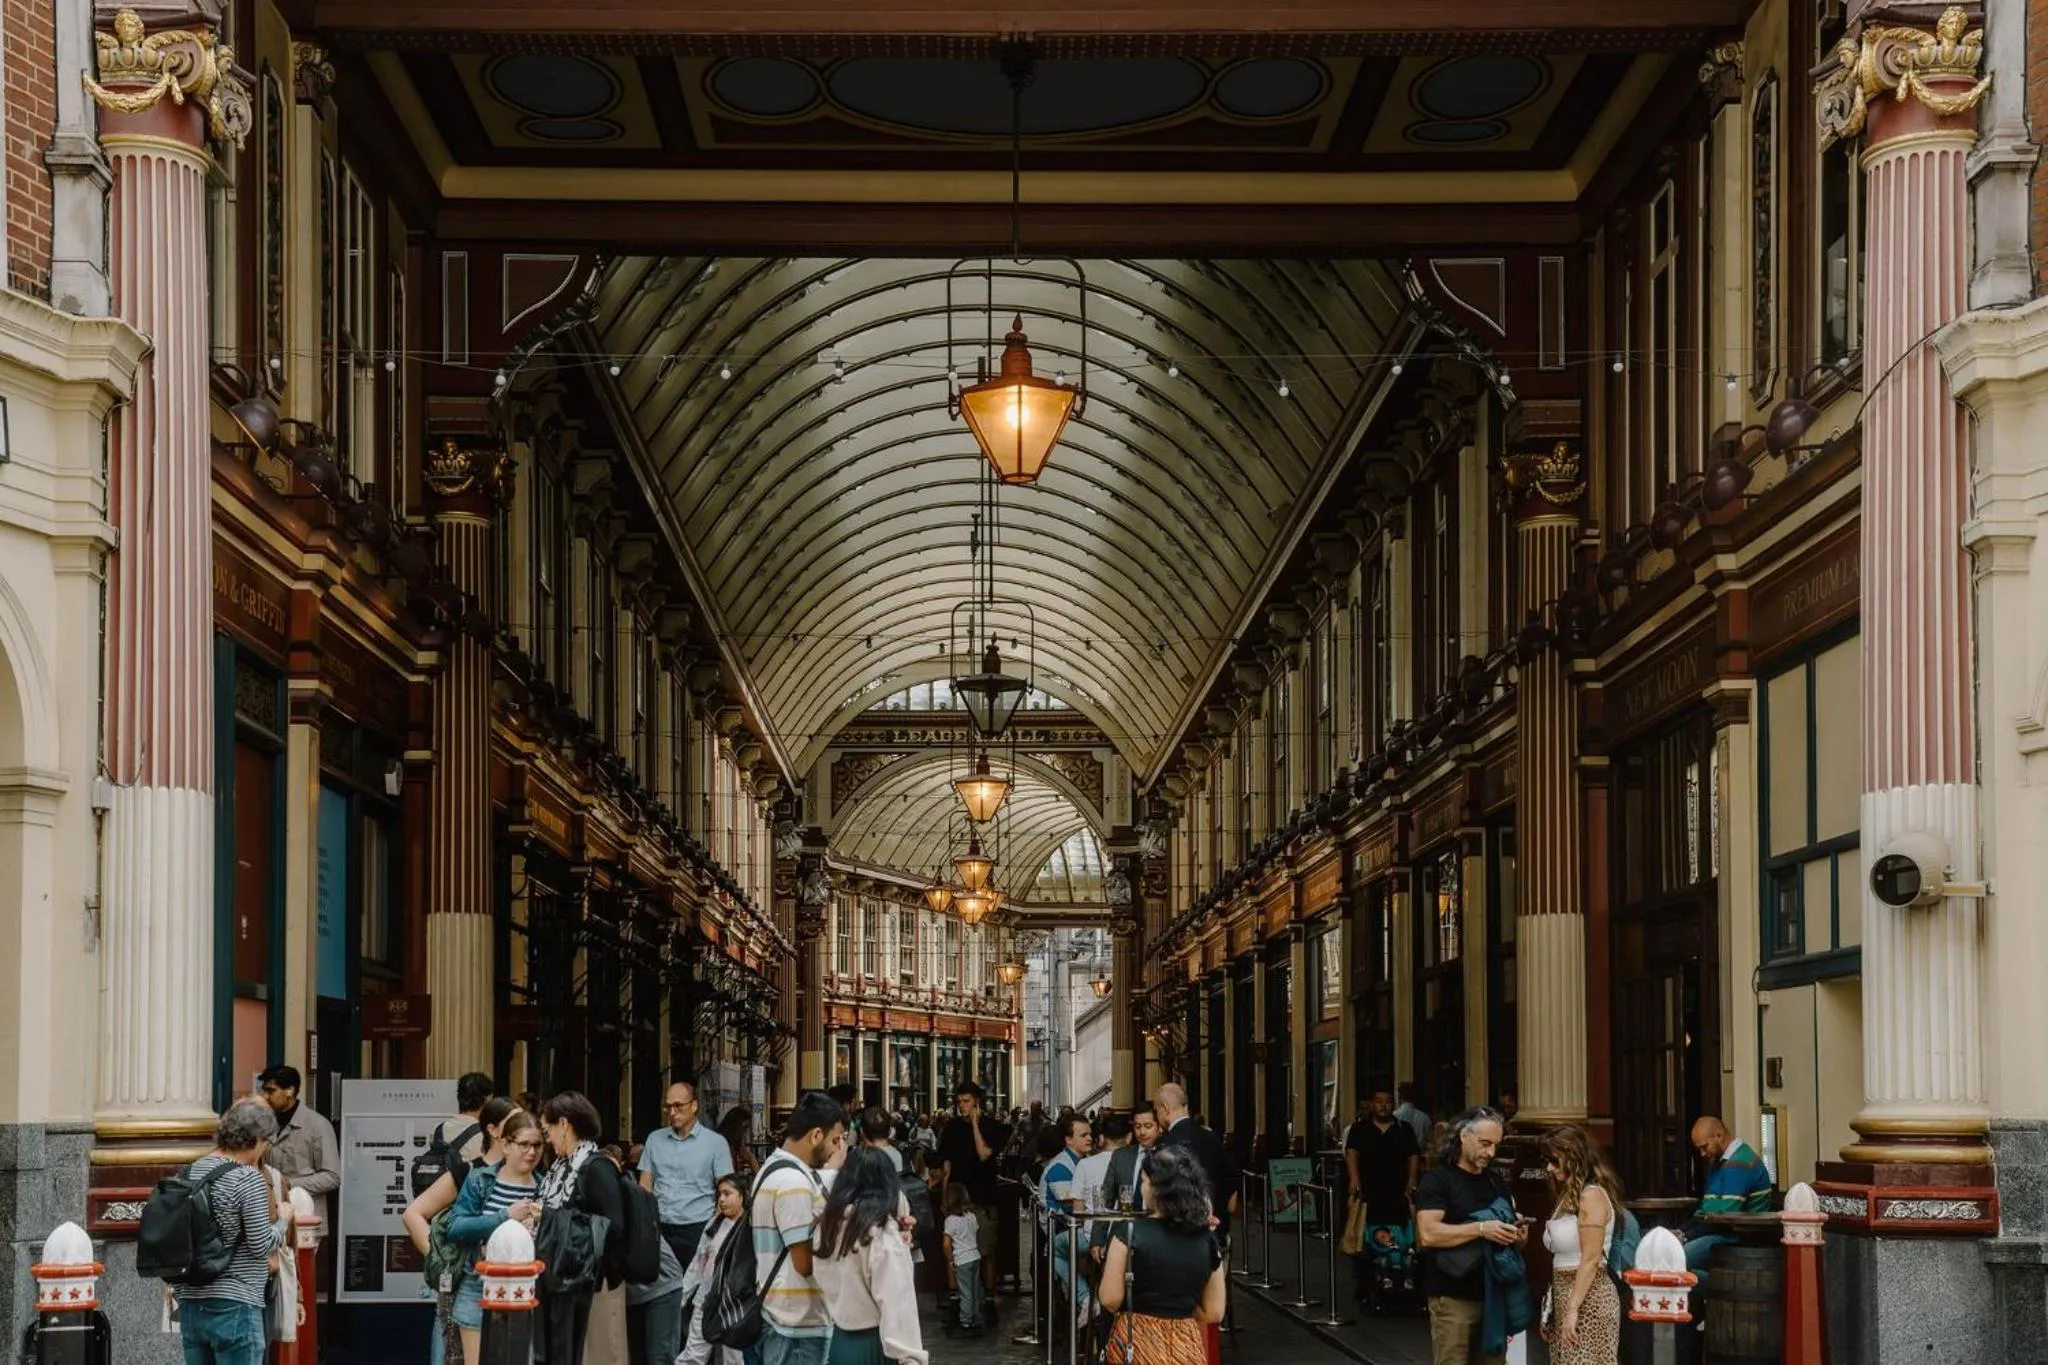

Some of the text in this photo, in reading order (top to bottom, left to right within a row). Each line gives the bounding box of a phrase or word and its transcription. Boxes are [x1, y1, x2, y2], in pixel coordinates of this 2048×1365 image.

[230, 573, 240, 604] &
[240, 582, 287, 637] GRIFFIN
[1784, 561, 1840, 620] PREMIUM
[1625, 645, 1700, 721] NEW MOON
[893, 729, 1046, 743] LEADEALL
